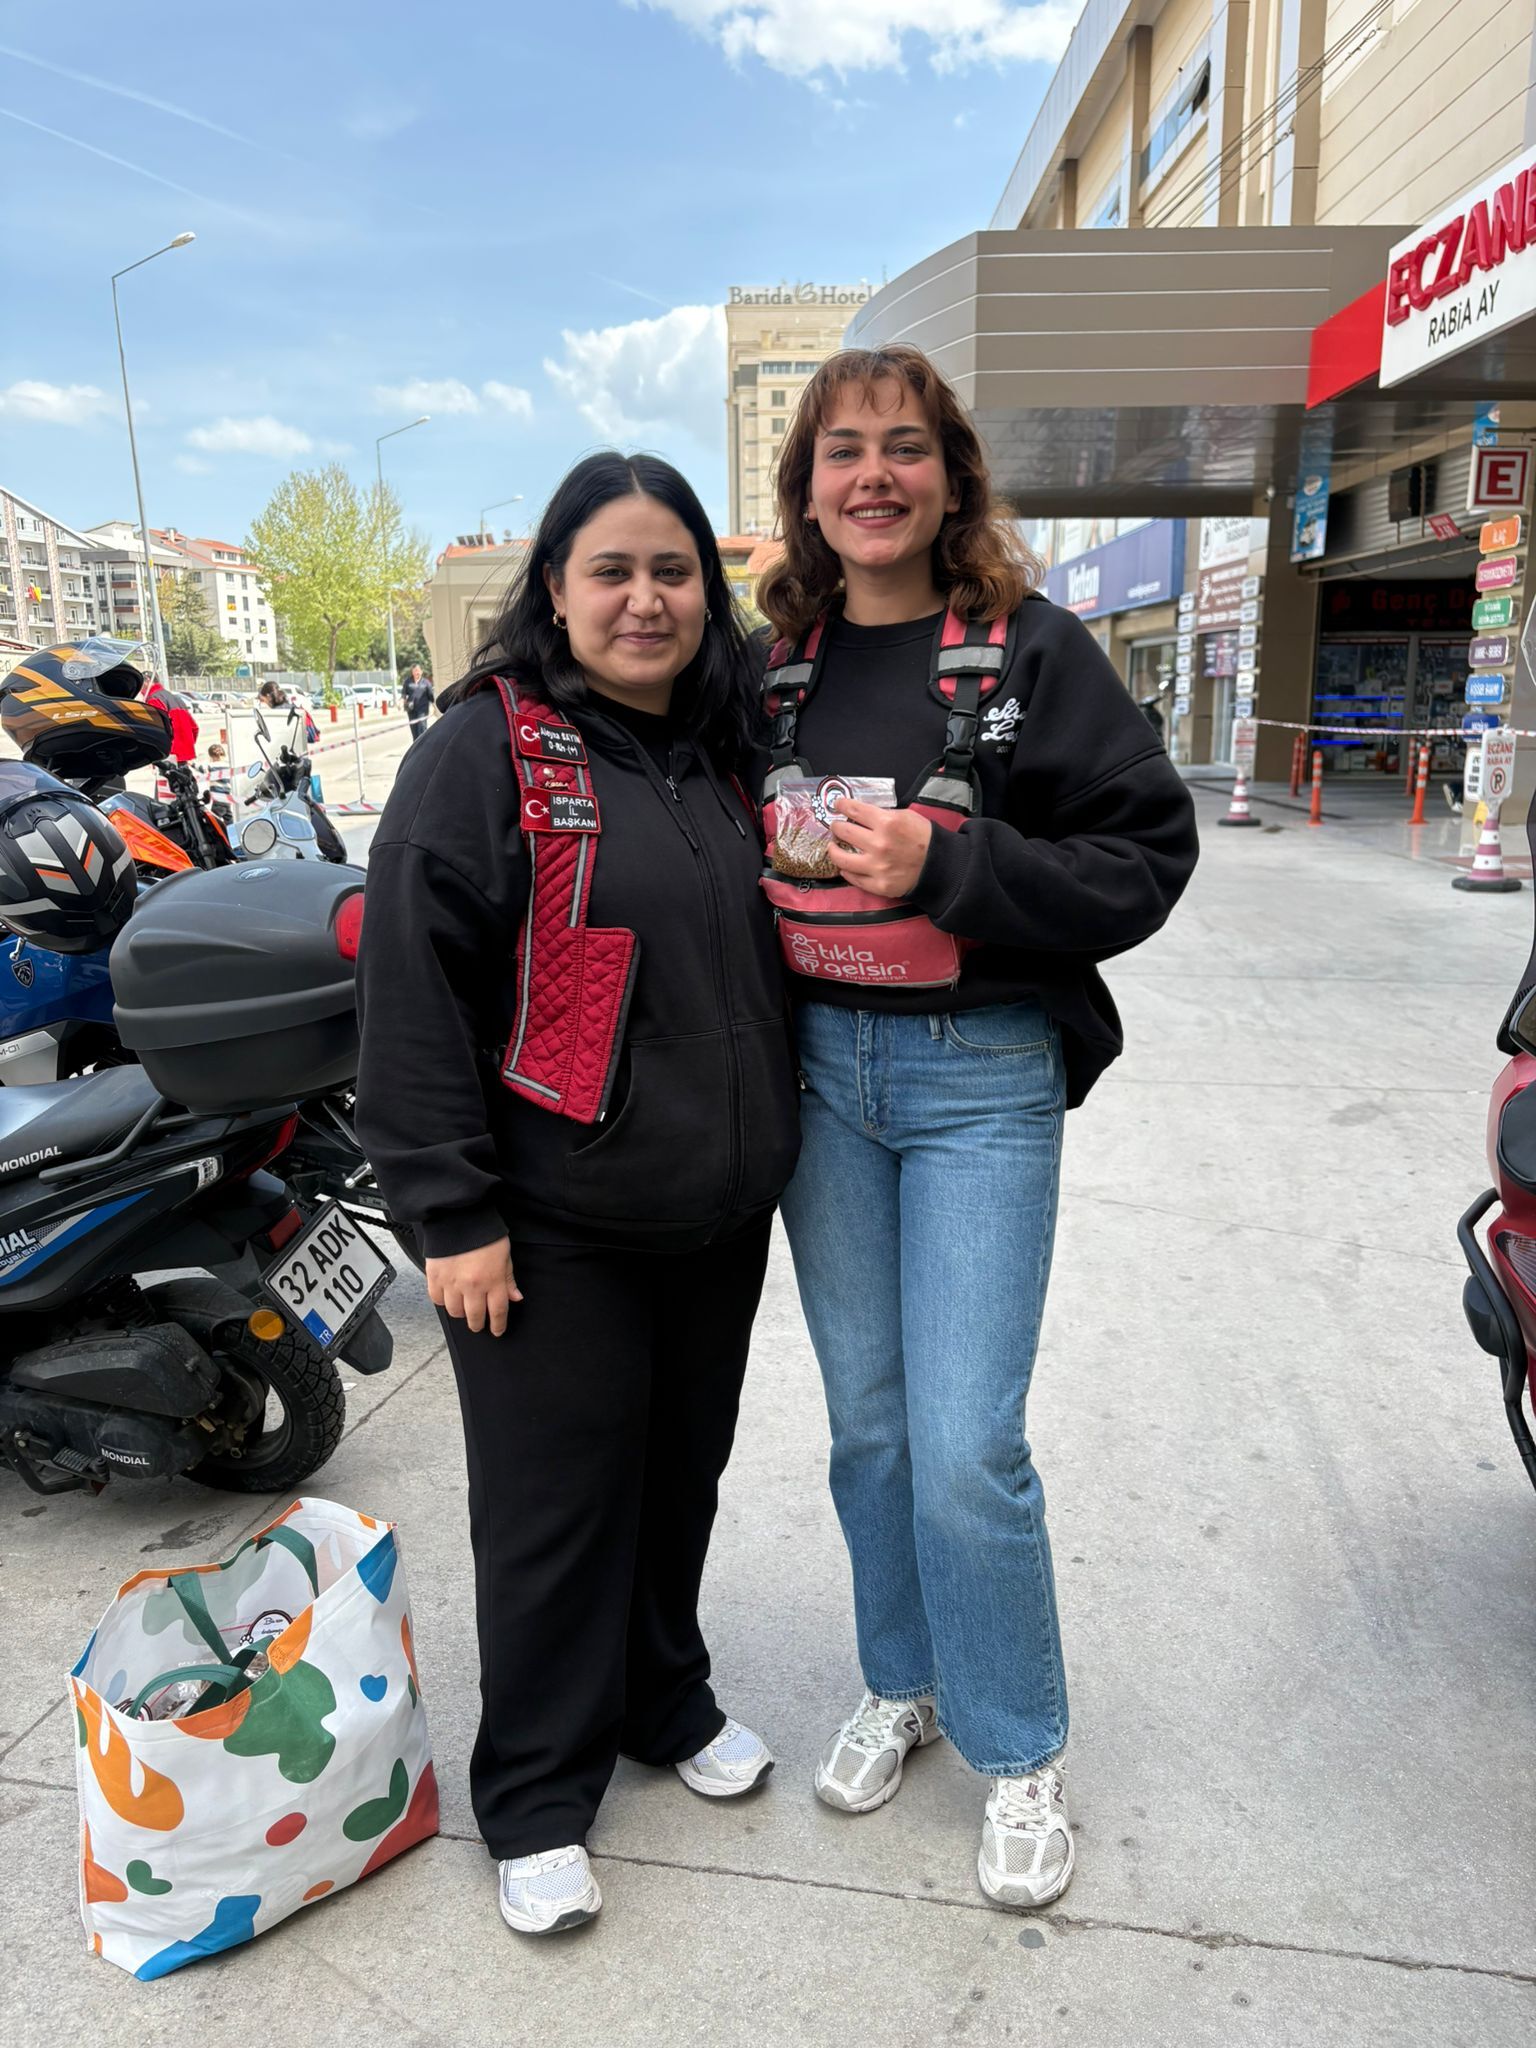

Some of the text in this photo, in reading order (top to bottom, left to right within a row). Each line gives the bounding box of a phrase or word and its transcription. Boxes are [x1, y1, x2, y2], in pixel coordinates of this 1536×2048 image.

[729, 286, 872, 305] Barida Hotel
[1476, 280, 1501, 321] AY
[1486, 460, 1517, 496] E
[553, 796, 594, 808] ISPARTA
[568, 804, 579, 816] İL
[553, 817, 597, 828] BAŞKANI
[818, 943, 874, 962] tıkla
[823, 962, 907, 977] gelsin
[0, 1146, 62, 1173] MONDIAL
[278, 1214, 356, 1305] 32 ADK
[323, 1264, 364, 1314] 110
[319, 1329, 333, 1343] TR
[101, 1448, 150, 1465] MONDIAL
